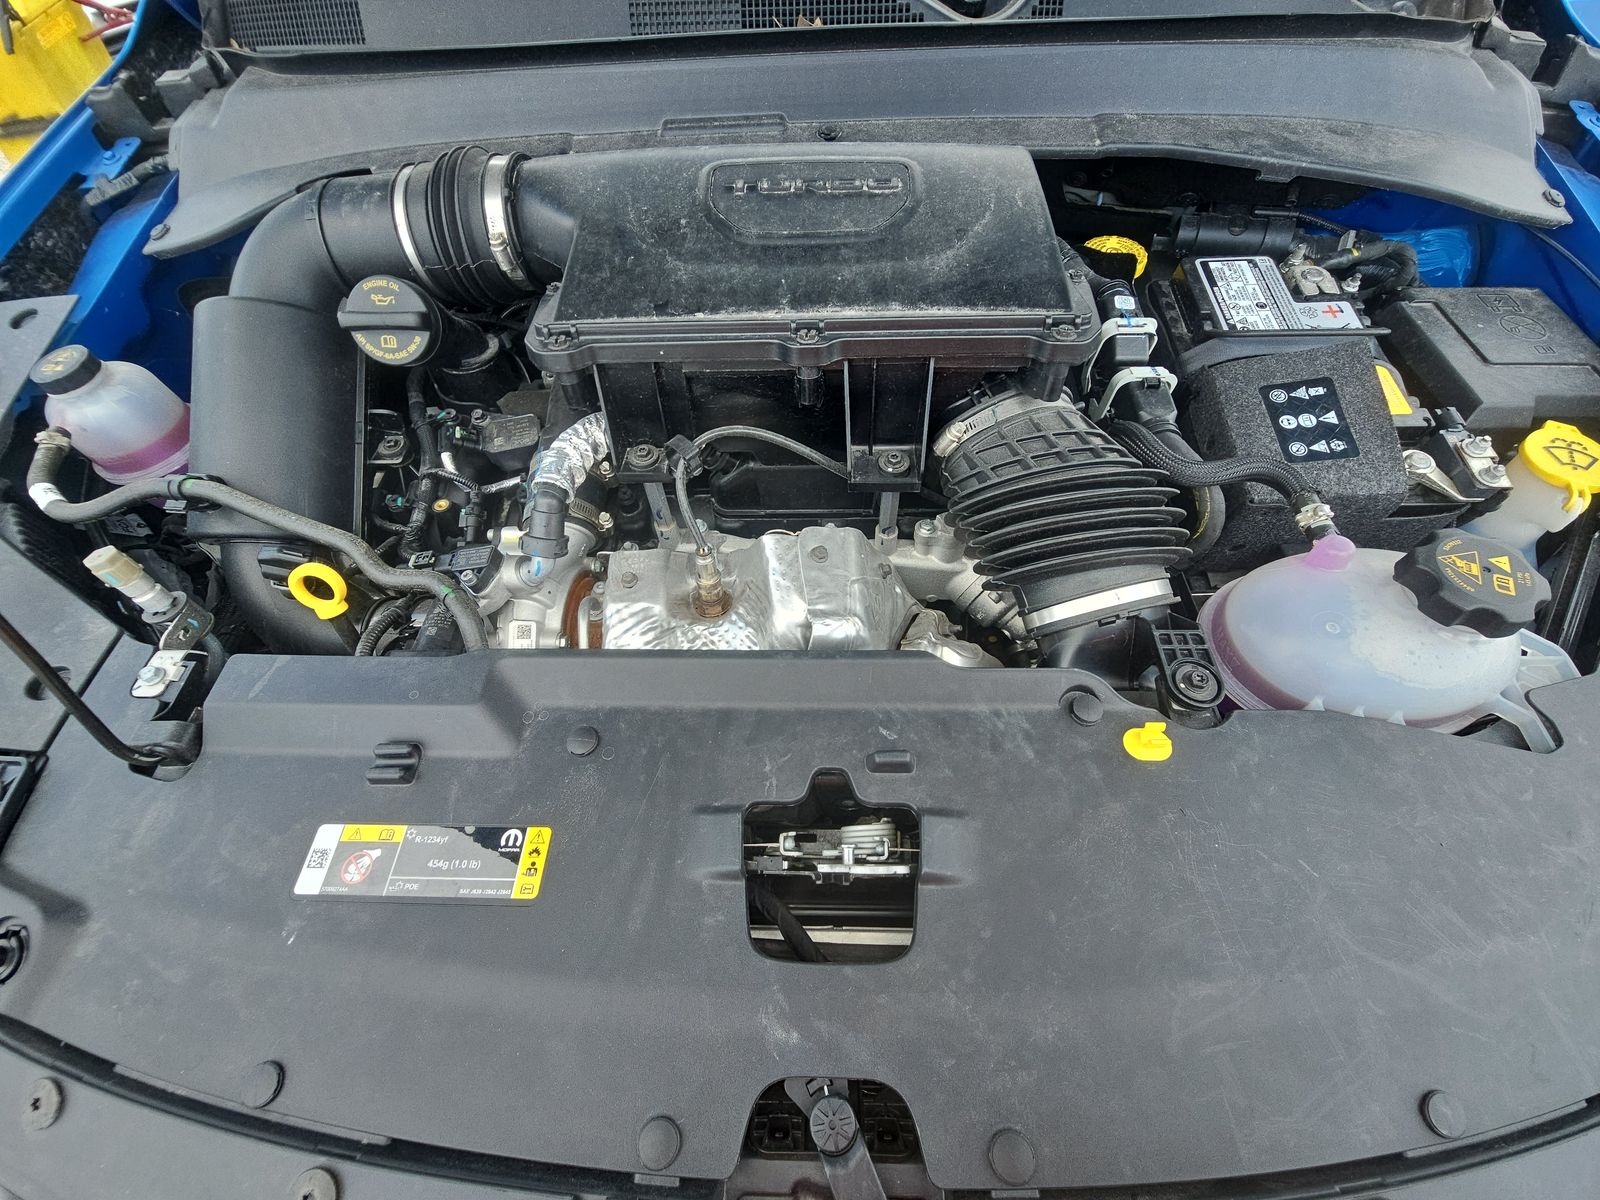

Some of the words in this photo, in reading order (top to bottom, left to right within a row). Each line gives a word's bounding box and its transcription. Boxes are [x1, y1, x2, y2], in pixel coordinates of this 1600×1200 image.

[363, 280, 387, 291] ENGINE
[389, 282, 400, 292] OIL
[356, 334, 366, 346] API
[414, 835, 449, 845] R-1234yf
[427, 859, 450, 870] 454g
[450, 859, 468, 870] (1.0
[468, 859, 481, 870] lb)
[403, 882, 421, 890] POE
